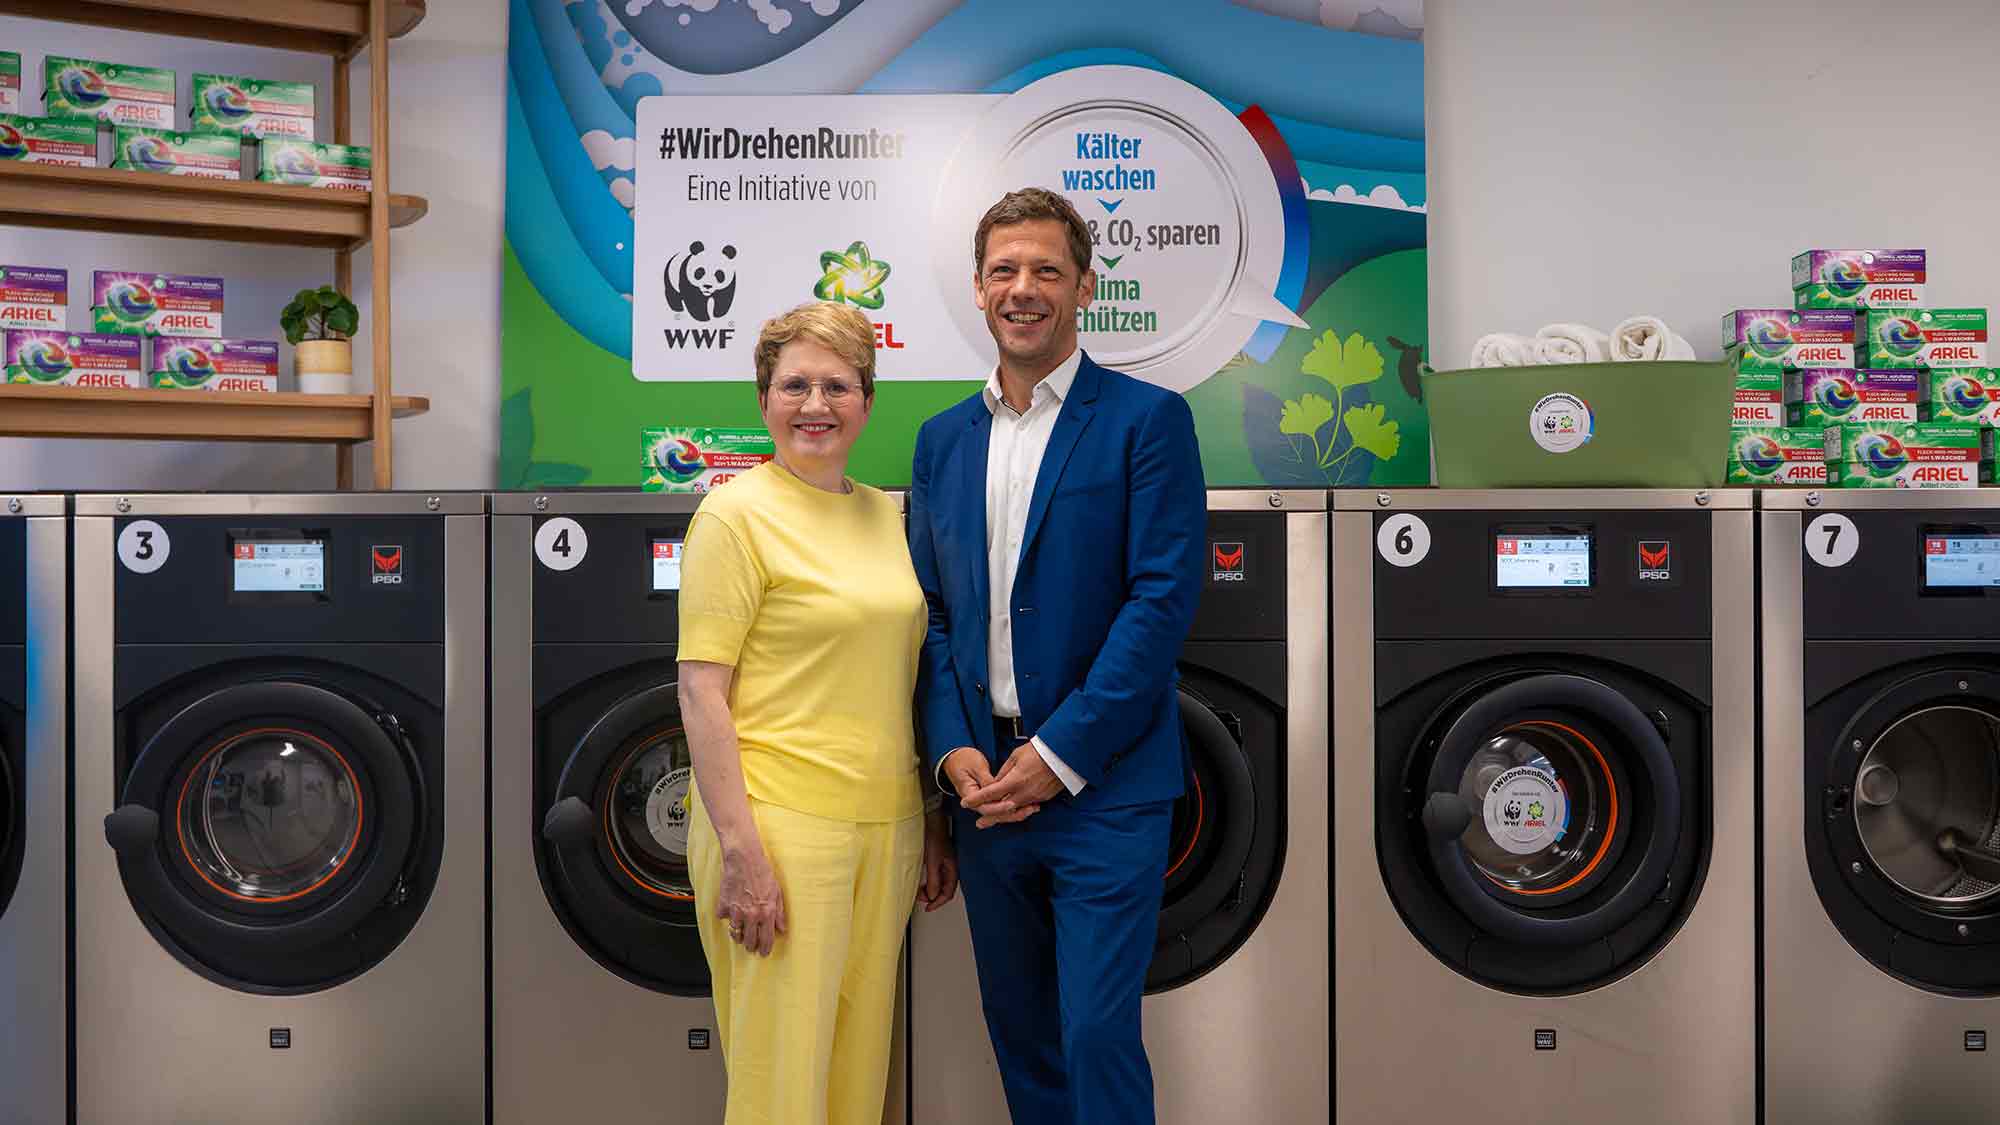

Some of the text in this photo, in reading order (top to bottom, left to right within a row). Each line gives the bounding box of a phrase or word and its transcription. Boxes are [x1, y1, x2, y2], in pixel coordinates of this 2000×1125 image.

[256, 119, 305, 133] ARIEL
[659, 127, 905, 160] #WirDrehenRunter
[1076, 132, 1142, 160] Kälter
[1062, 164, 1156, 191] waschen
[688, 174, 877, 201] Eine Initiative von
[1147, 223, 1220, 251] sparen
[1094, 274, 1140, 301] lima
[1870, 288, 1918, 301] ARIEL
[1, 306, 56, 322] ARIEL
[161, 315, 214, 329] ARIEL
[1074, 306, 1157, 332] chützen
[664, 328, 735, 350] WWF
[1797, 347, 1846, 361] ARIEL
[1929, 347, 1979, 360] ARIEL
[76, 373, 128, 387] ARIEL
[218, 378, 269, 392] ARIEL
[1862, 407, 1910, 420] ARIEL
[1787, 466, 1827, 478] ARIE
[1912, 467, 1969, 481] ARIEL
[135, 531, 154, 560] 3
[552, 528, 571, 557] 4
[1394, 525, 1414, 555] 6
[1822, 525, 1841, 555] 7
[373, 575, 402, 584] IPSO
[1214, 572, 1244, 581] IPSO
[1640, 571, 1670, 580] IPSO
[1491, 768, 1559, 794] #WirDrehenRunter
